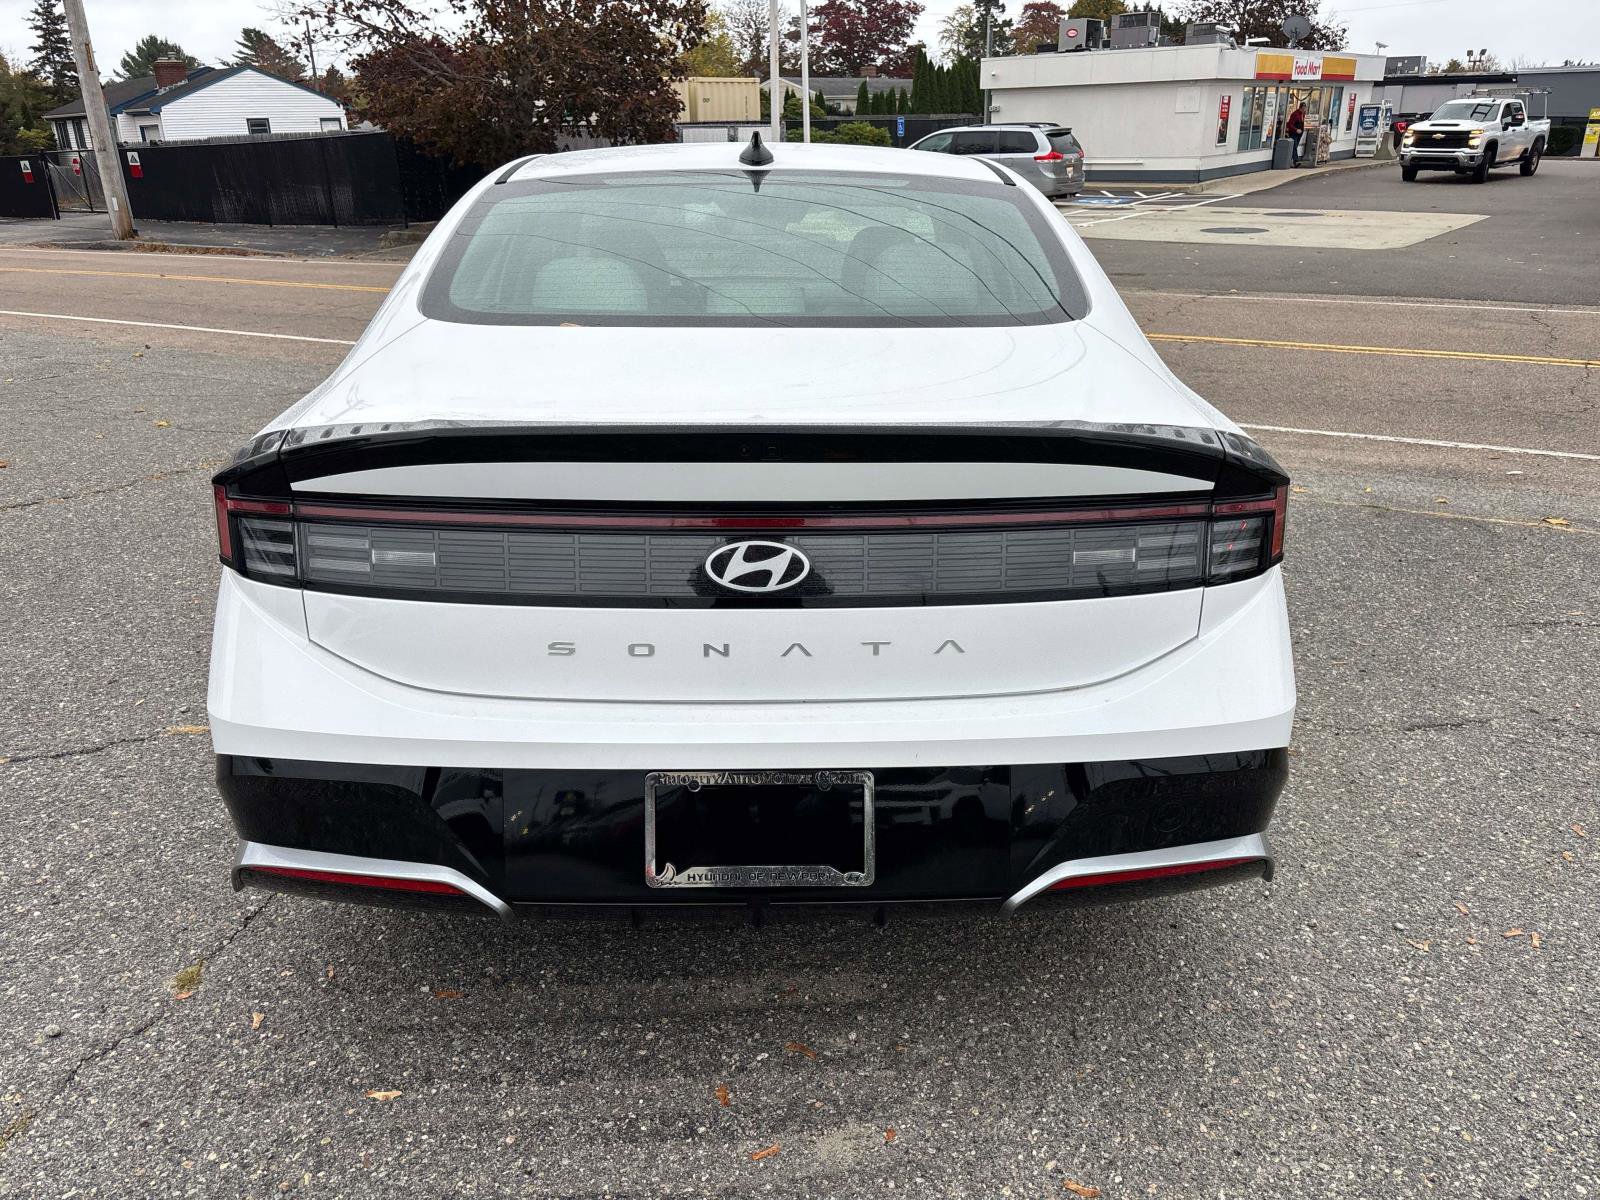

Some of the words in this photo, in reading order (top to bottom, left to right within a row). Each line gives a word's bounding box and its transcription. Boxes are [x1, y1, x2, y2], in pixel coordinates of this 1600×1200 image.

[1295, 60, 1308, 75] Food
[1308, 61, 1321, 75] Mart
[547, 639, 966, 658] SONATA
[687, 872, 742, 882] HYUNDAI
[748, 872, 764, 881] OF
